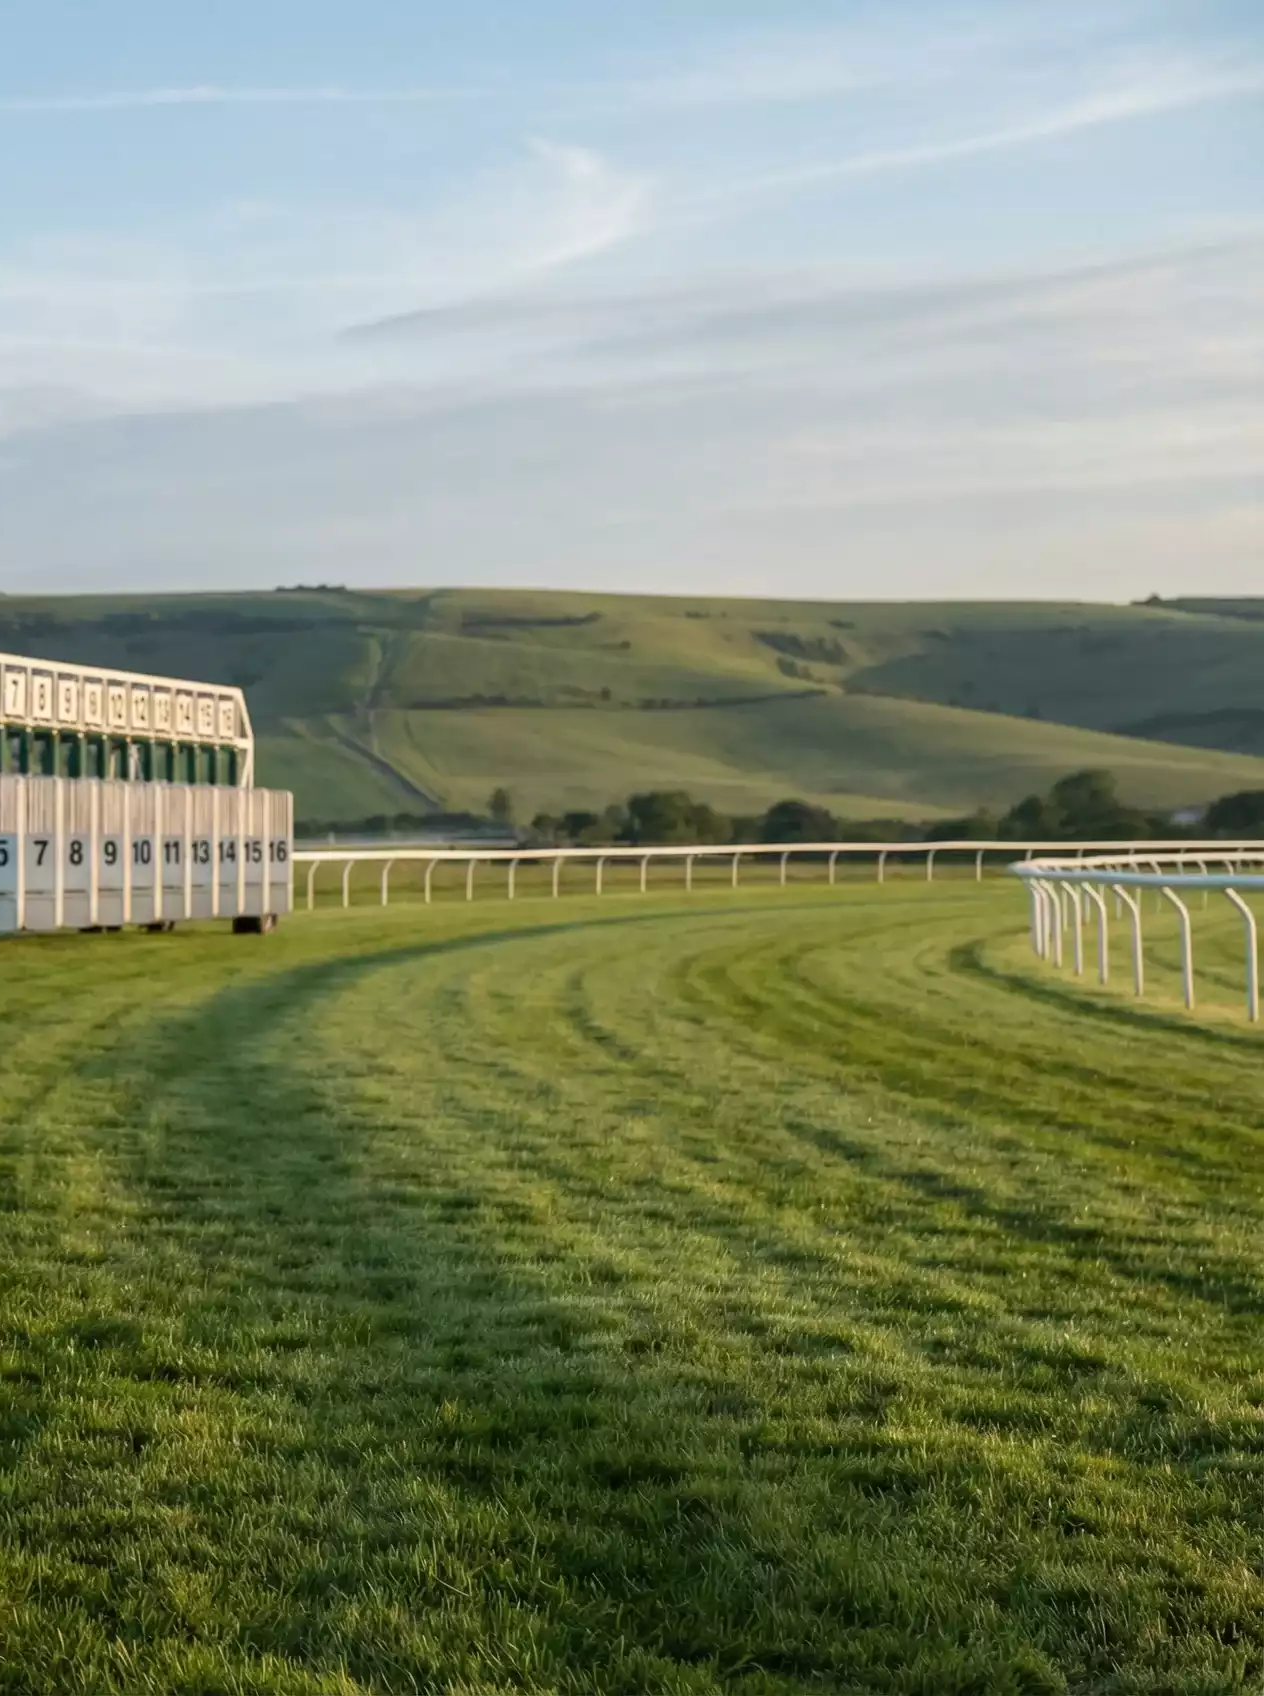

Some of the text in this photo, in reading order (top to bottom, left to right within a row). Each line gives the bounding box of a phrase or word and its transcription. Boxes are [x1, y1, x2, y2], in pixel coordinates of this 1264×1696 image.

[11, 678, 19, 708] 7
[33, 840, 49, 866] 7
[69, 840, 84, 866] 8
[104, 840, 118, 866] 9
[132, 840, 152, 865] 10
[163, 840, 181, 864] 11
[191, 839, 210, 864] 13
[219, 840, 237, 863] 14
[244, 840, 262, 863] 15
[269, 840, 287, 863] 16
